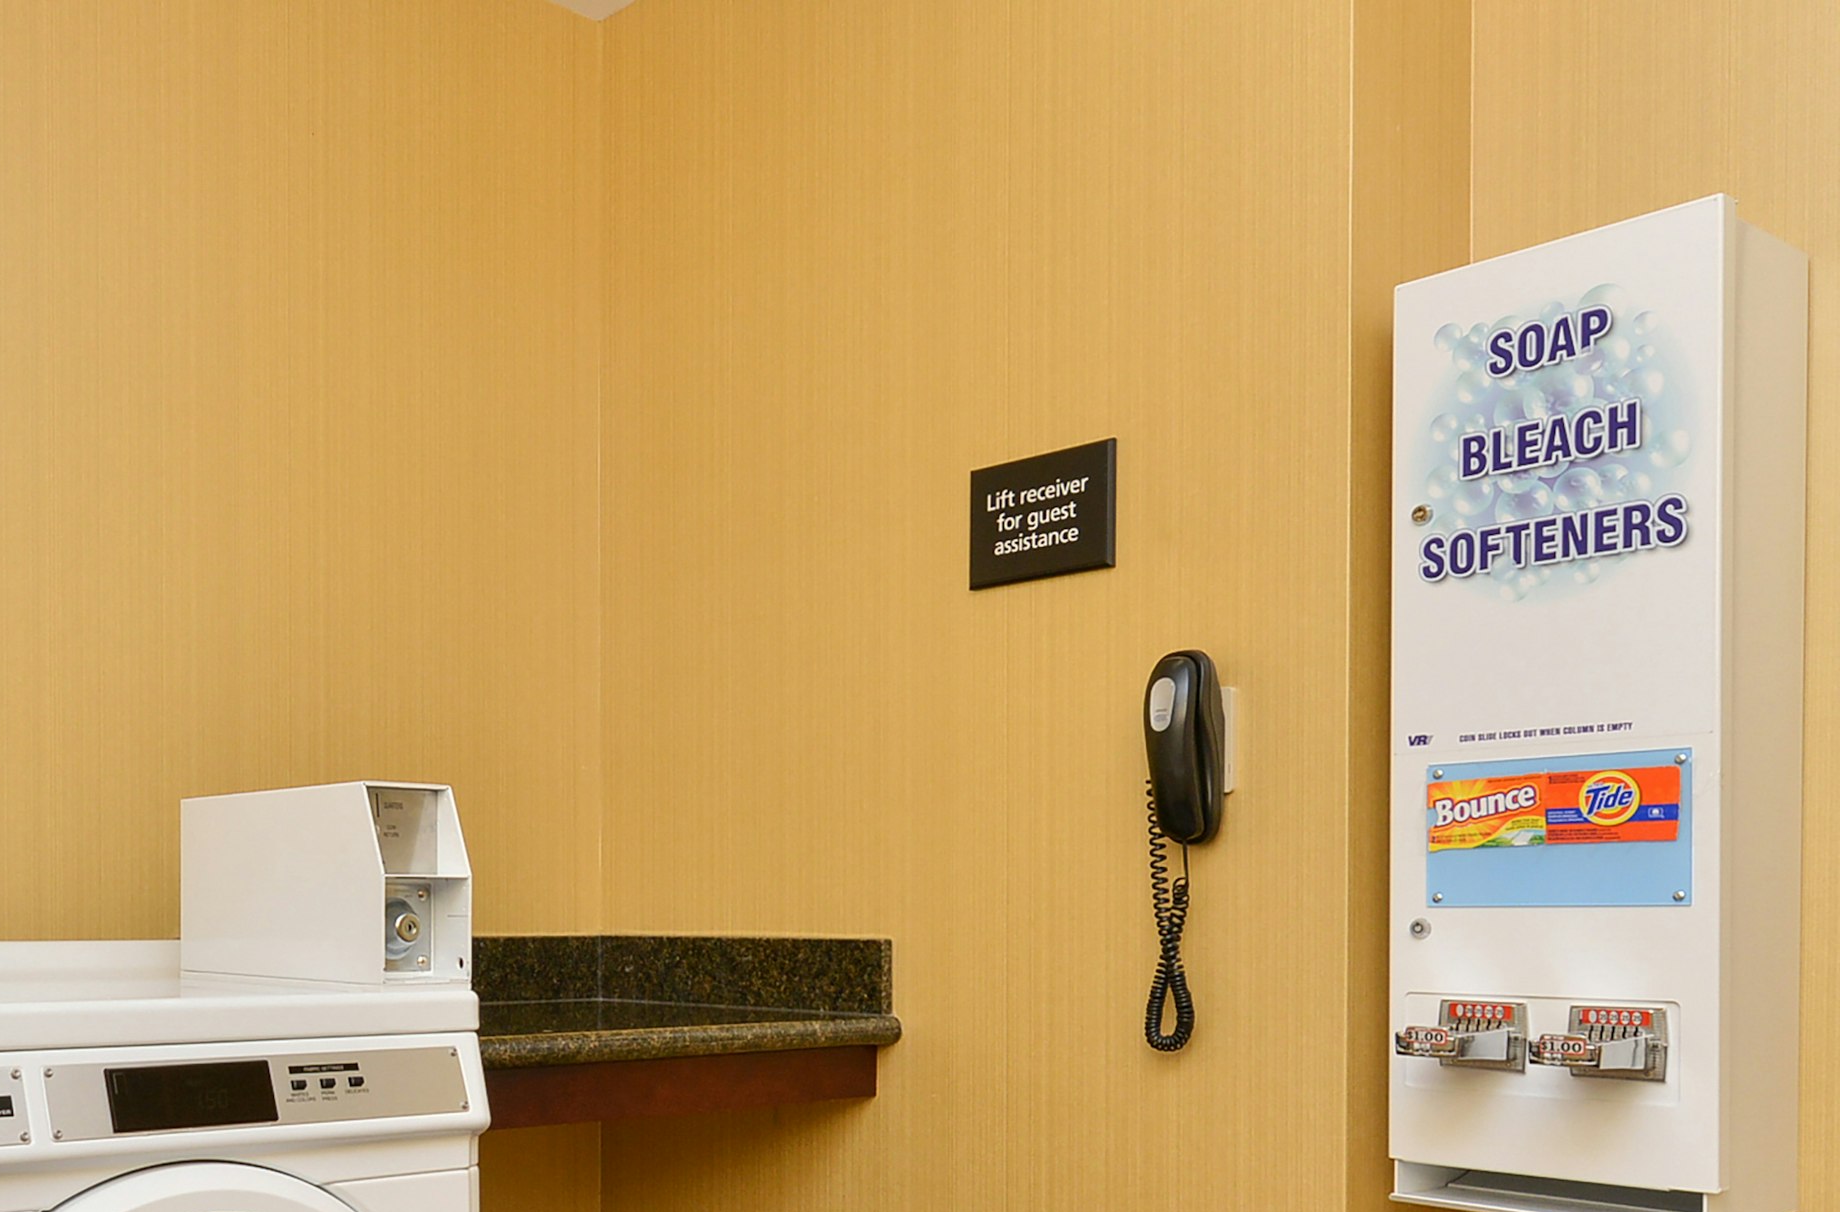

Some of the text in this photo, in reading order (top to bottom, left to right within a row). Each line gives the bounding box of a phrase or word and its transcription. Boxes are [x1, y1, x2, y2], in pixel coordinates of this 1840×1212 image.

[1487, 306, 1611, 377] SOAP
[1461, 400, 1640, 479] BLEACH
[986, 476, 1089, 512] Lift receiver
[996, 501, 1077, 533] for guest
[994, 527, 1079, 556] assistance
[1421, 496, 1686, 581] SOFTENERS
[1459, 722, 1633, 743] COIN SLIDE LOCKS OUT WHEN COLUMN IS EMPTY
[1434, 785, 1536, 828] Bounce
[1584, 783, 1635, 816] Tide
[1407, 1031, 1444, 1042] $1.00
[1540, 1041, 1582, 1053] $1.00
